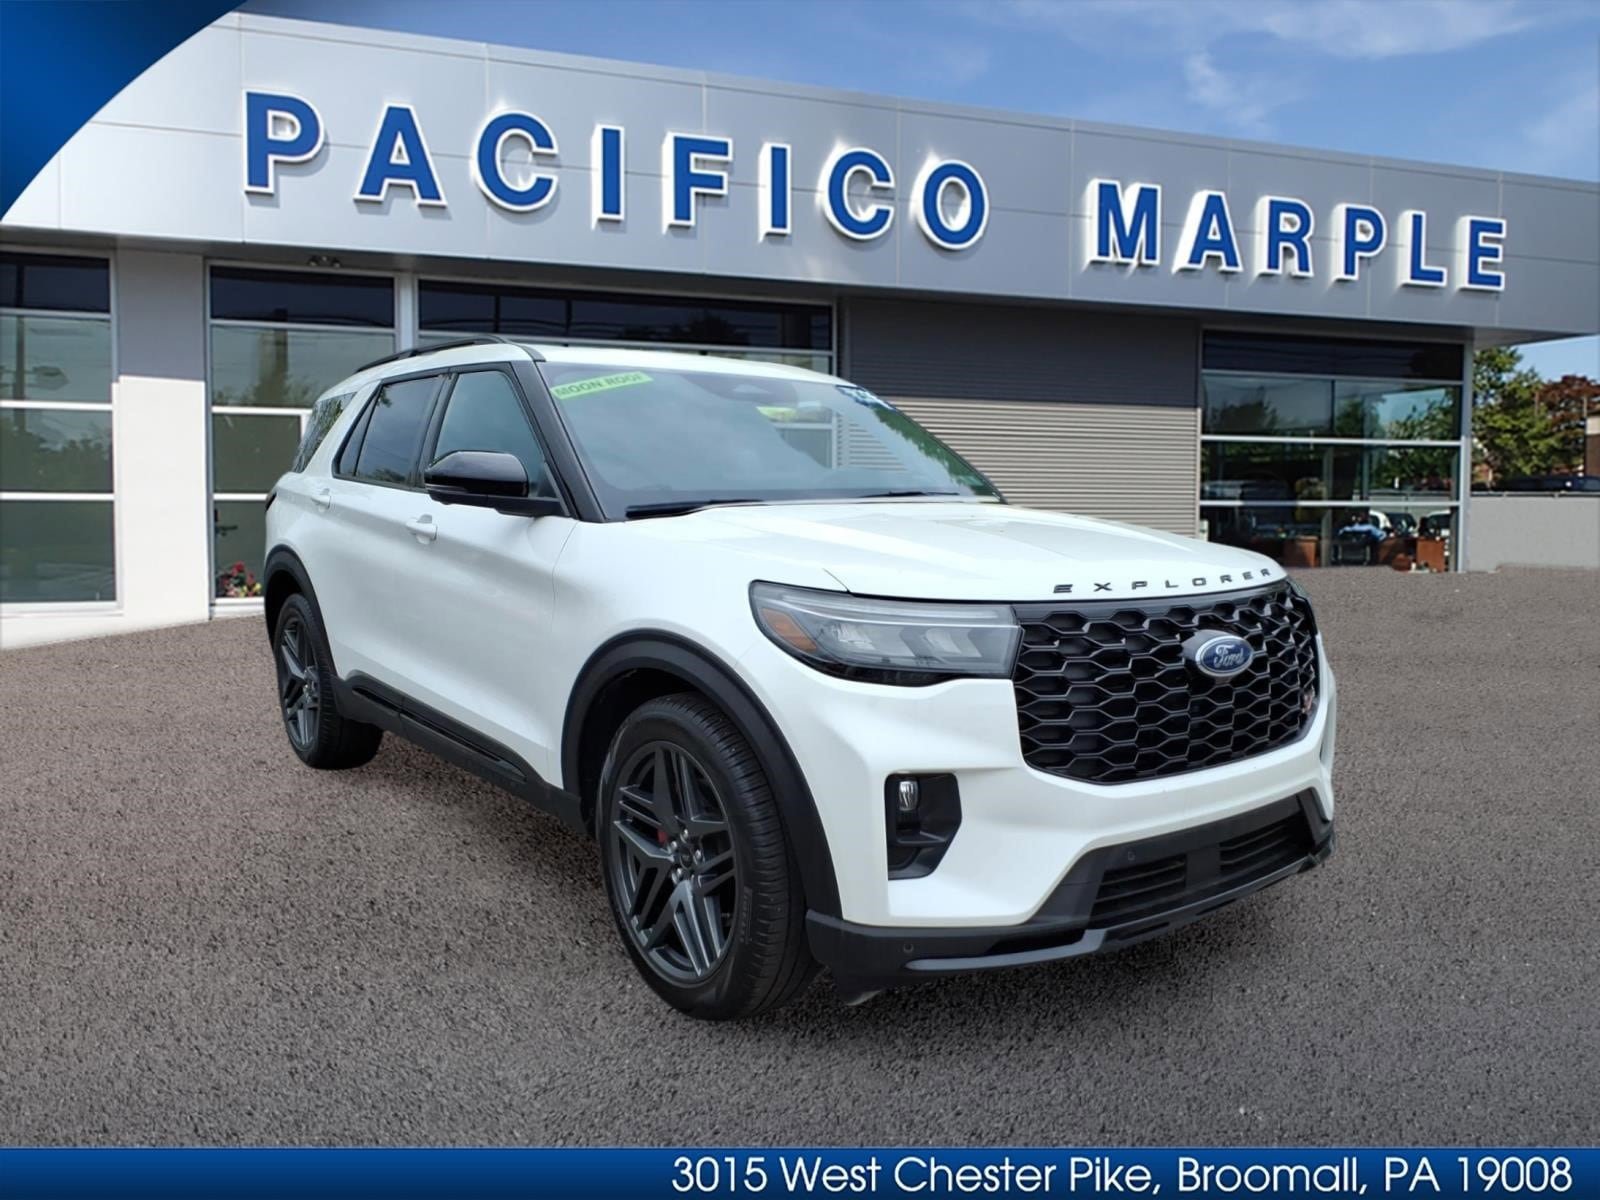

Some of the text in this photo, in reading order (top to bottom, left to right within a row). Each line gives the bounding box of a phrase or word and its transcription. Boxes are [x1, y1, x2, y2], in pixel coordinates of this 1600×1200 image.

[243, 90, 1507, 291] PACIFICO MARPLE
[1053, 568, 1272, 594] EXPLORER
[1212, 643, 1246, 668] Ford
